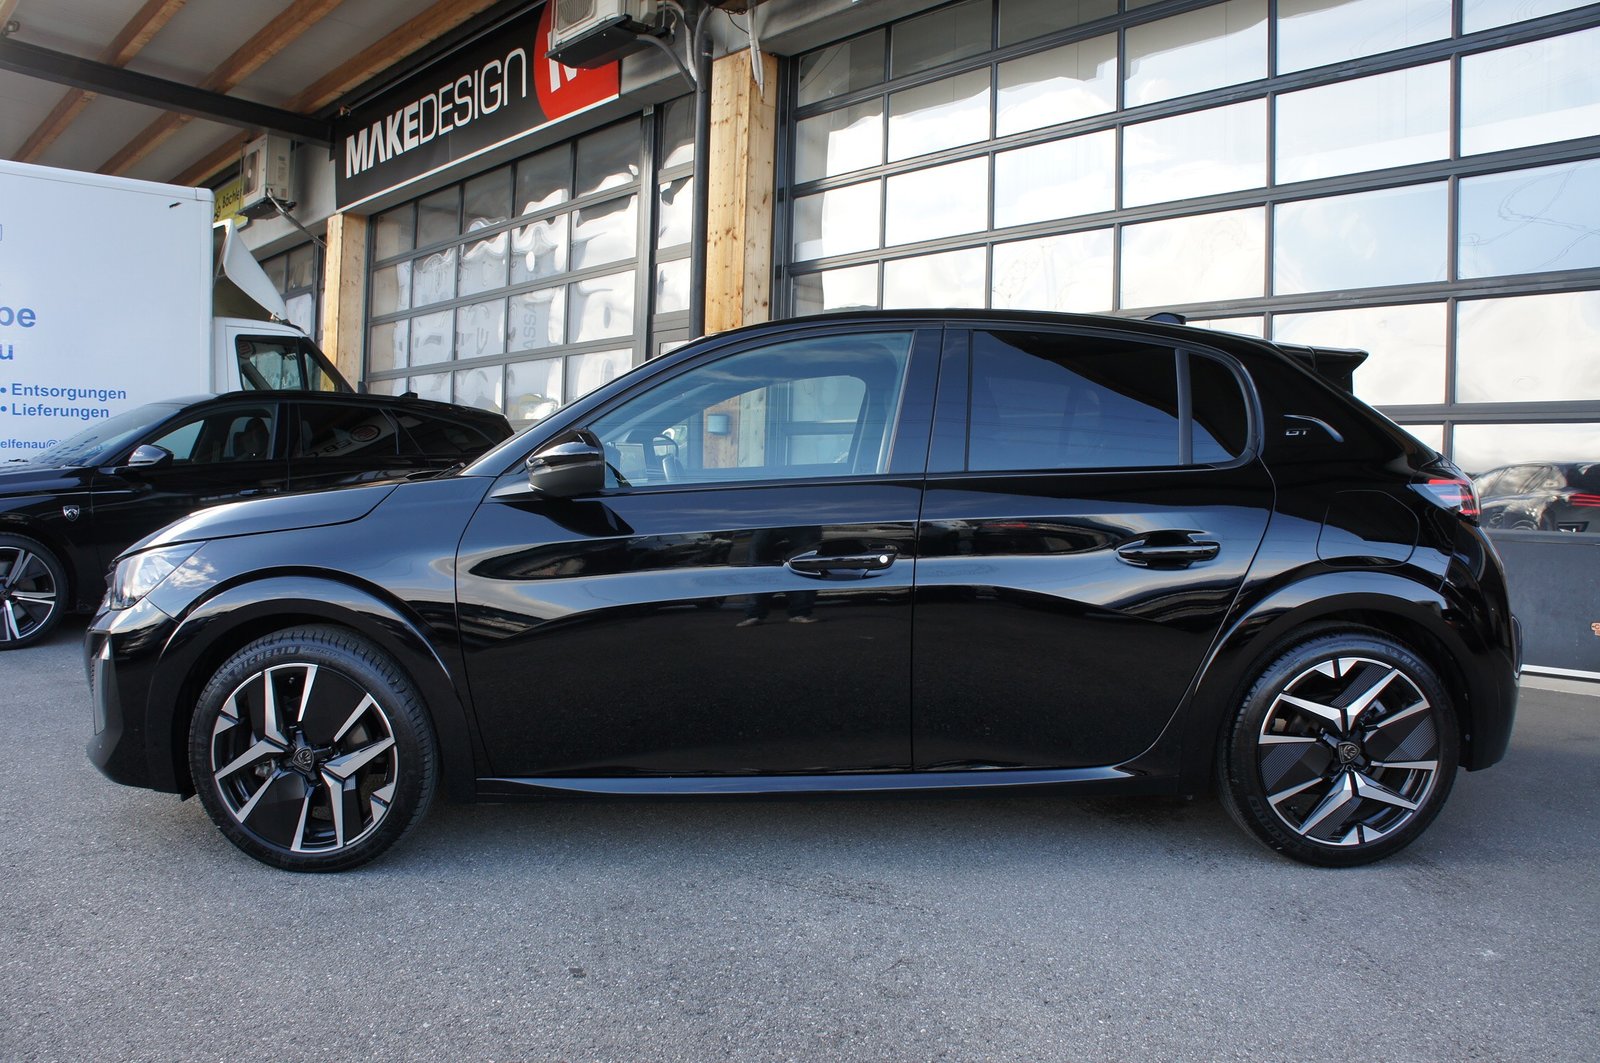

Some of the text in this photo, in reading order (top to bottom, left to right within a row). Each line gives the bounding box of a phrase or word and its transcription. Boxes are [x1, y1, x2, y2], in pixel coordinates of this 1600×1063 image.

[346, 47, 527, 179] MAKEDESIGN
[11, 383, 126, 401] Entsorgungen
[12, 403, 109, 420] Lieferungen
[233, 646, 297, 675] MICHELIN
